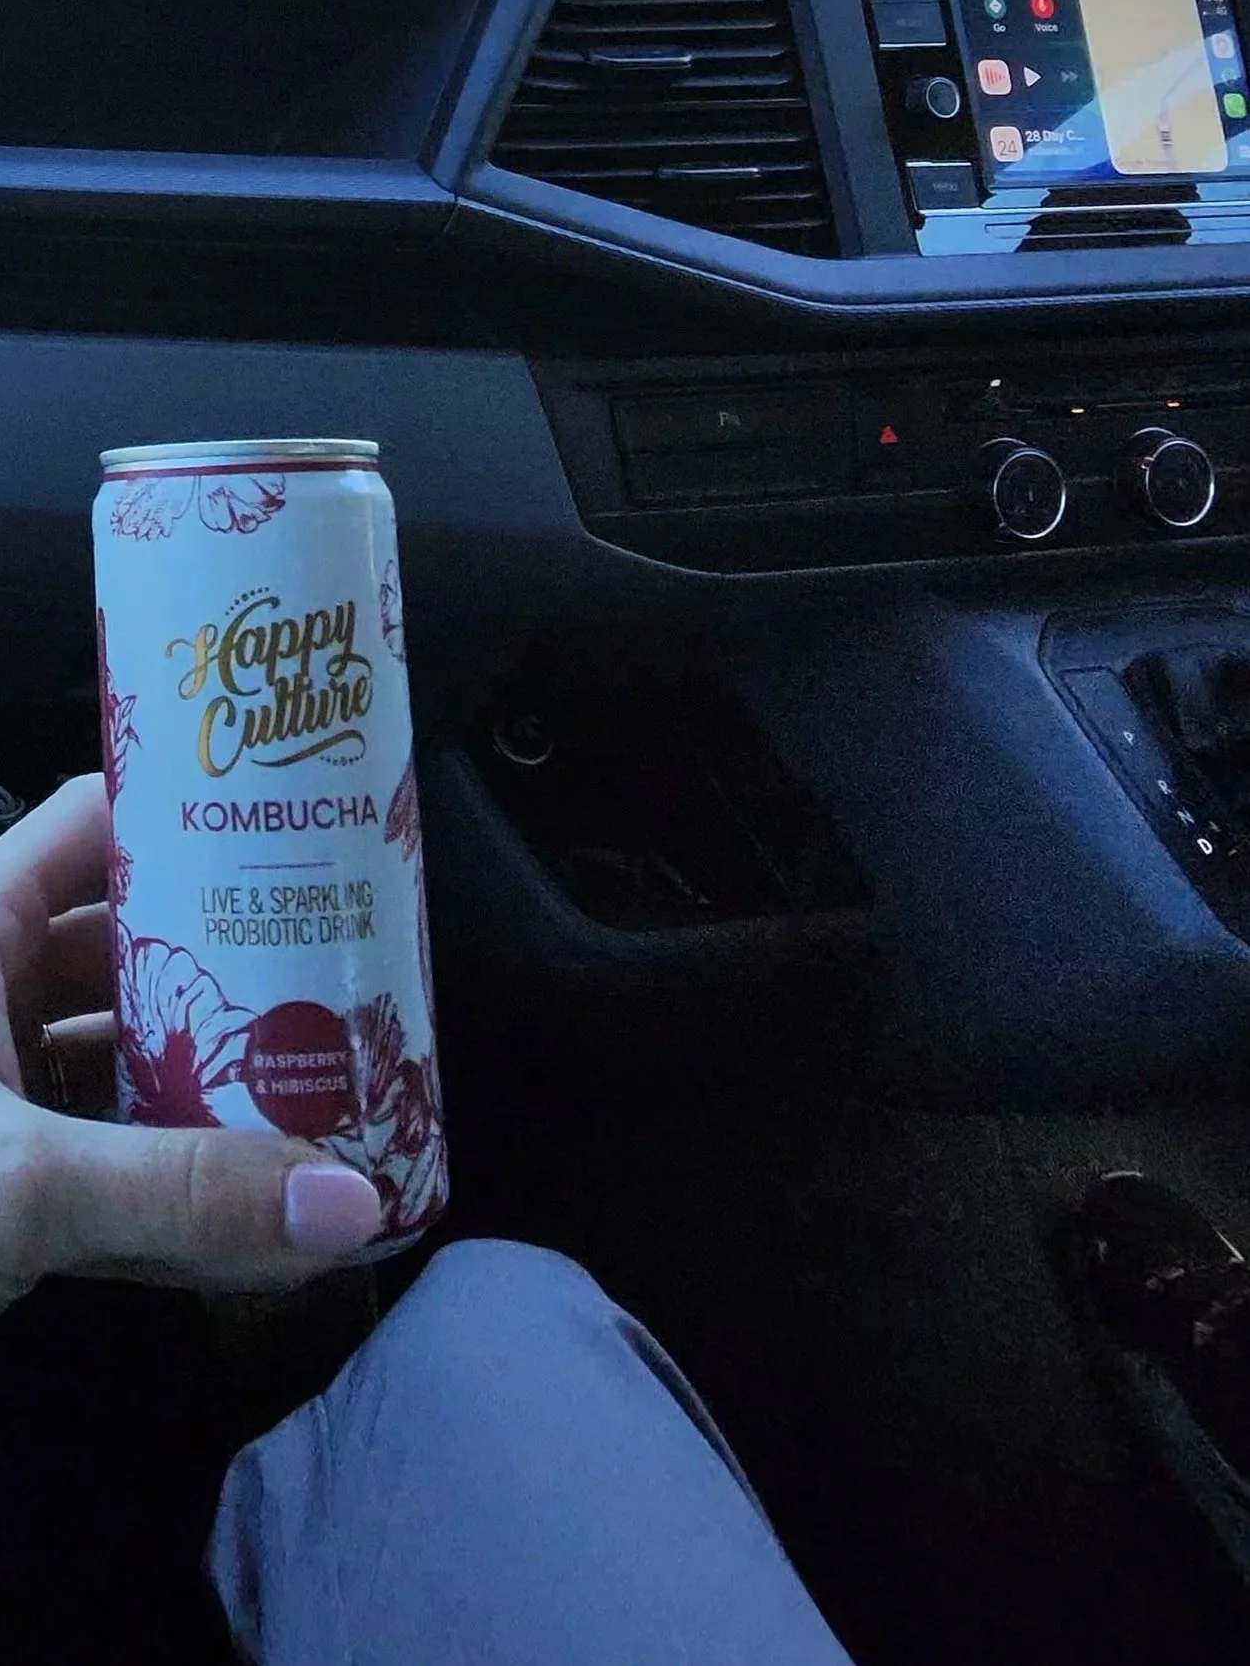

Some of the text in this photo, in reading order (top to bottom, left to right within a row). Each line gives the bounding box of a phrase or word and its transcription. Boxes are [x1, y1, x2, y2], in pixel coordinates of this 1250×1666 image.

[993, 23, 1007, 33] Go
[1034, 22, 1059, 33] Voice
[1024, 129, 1041, 142] 28
[997, 139, 1018, 156] 24
[165, 596, 373, 700] Happy
[198, 672, 373, 777] Culture
[1157, 779, 1173, 794] R
[181, 794, 379, 833] KOMBUCHA
[1197, 838, 1213, 855] D
[201, 880, 374, 914] LIVE & SPARKLING
[205, 910, 375, 946] PROBIOTIC DRINK
[253, 1050, 350, 1068] RASPBERRY
[255, 1075, 348, 1095] & HIBISCUS
